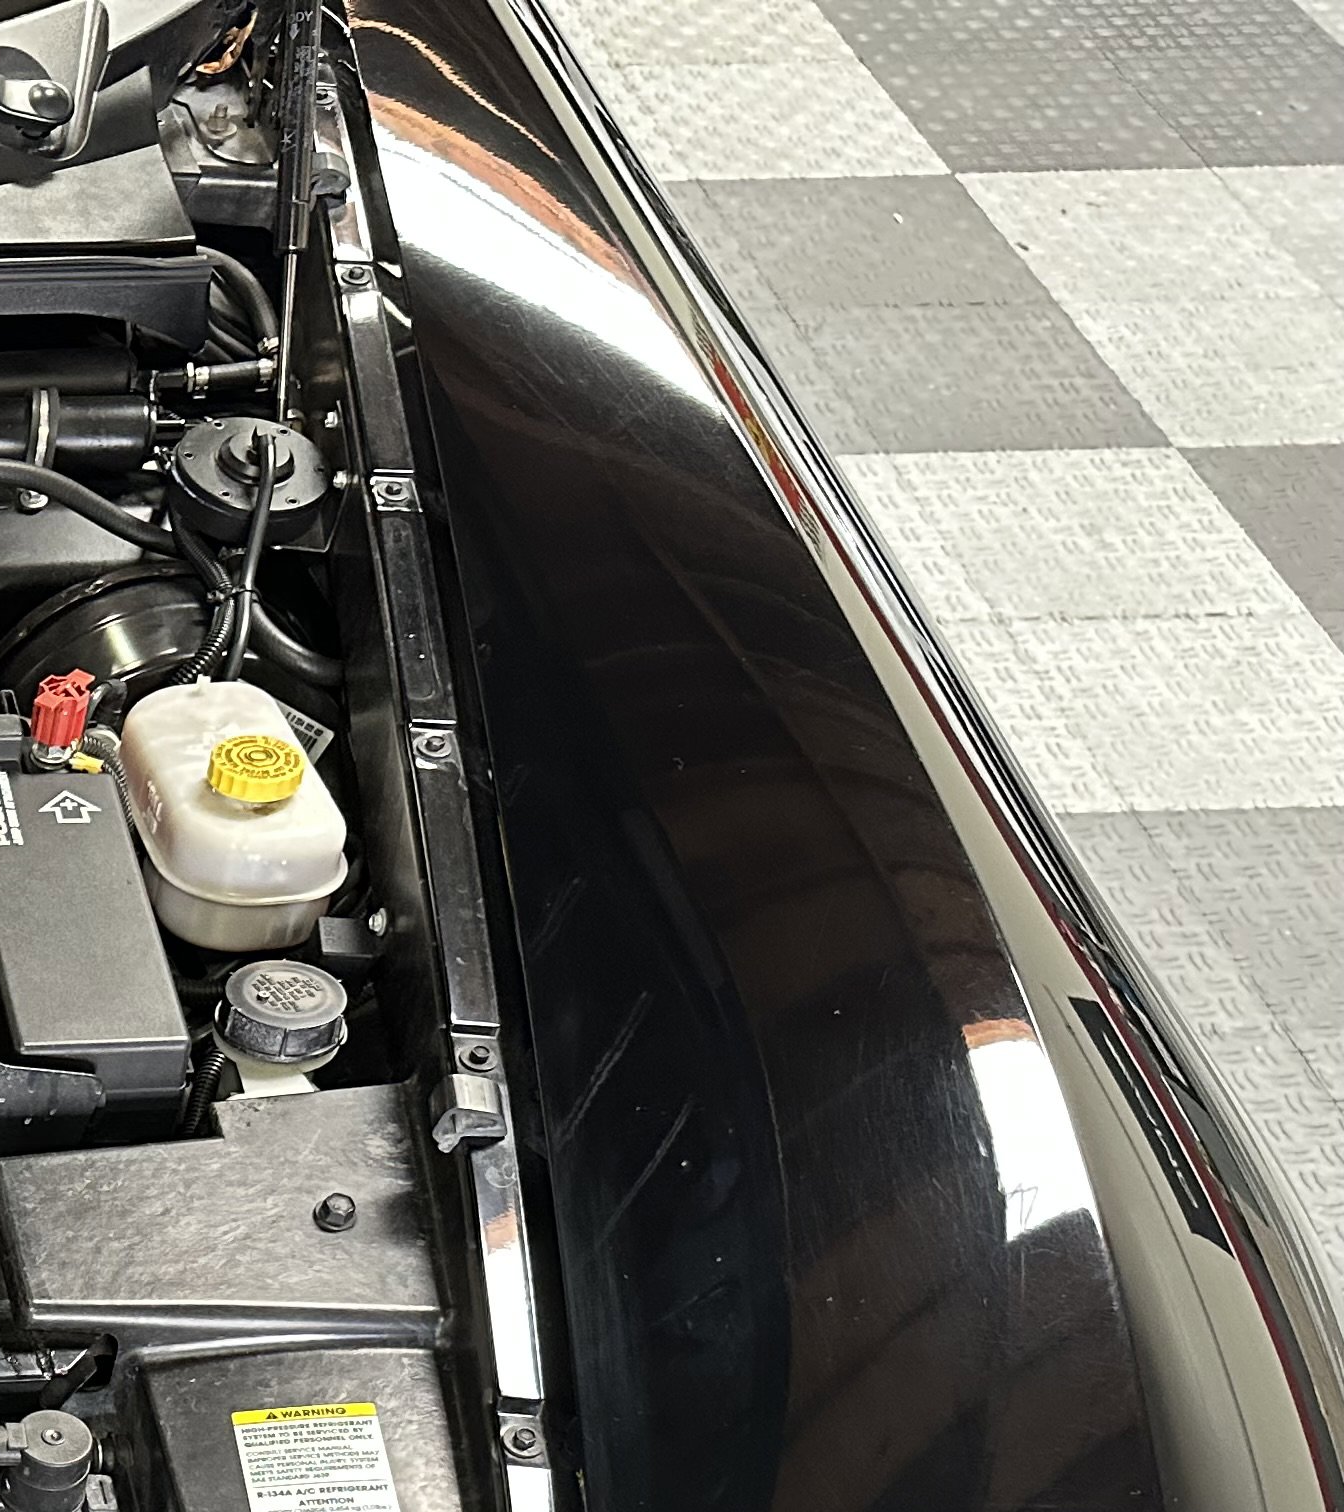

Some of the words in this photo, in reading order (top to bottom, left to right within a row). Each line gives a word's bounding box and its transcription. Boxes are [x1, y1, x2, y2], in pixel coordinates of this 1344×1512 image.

[281, 1408, 346, 1418] WARNING
[313, 1420, 373, 1428] REFRIGERANT
[306, 1428, 349, 1436] SERVICED
[244, 1439, 290, 1448] QUALIFIED
[257, 1490, 292, 1498] R-134A
[319, 1484, 388, 1494] REFRIGERANT
[299, 1497, 354, 1506] ATTENTION
